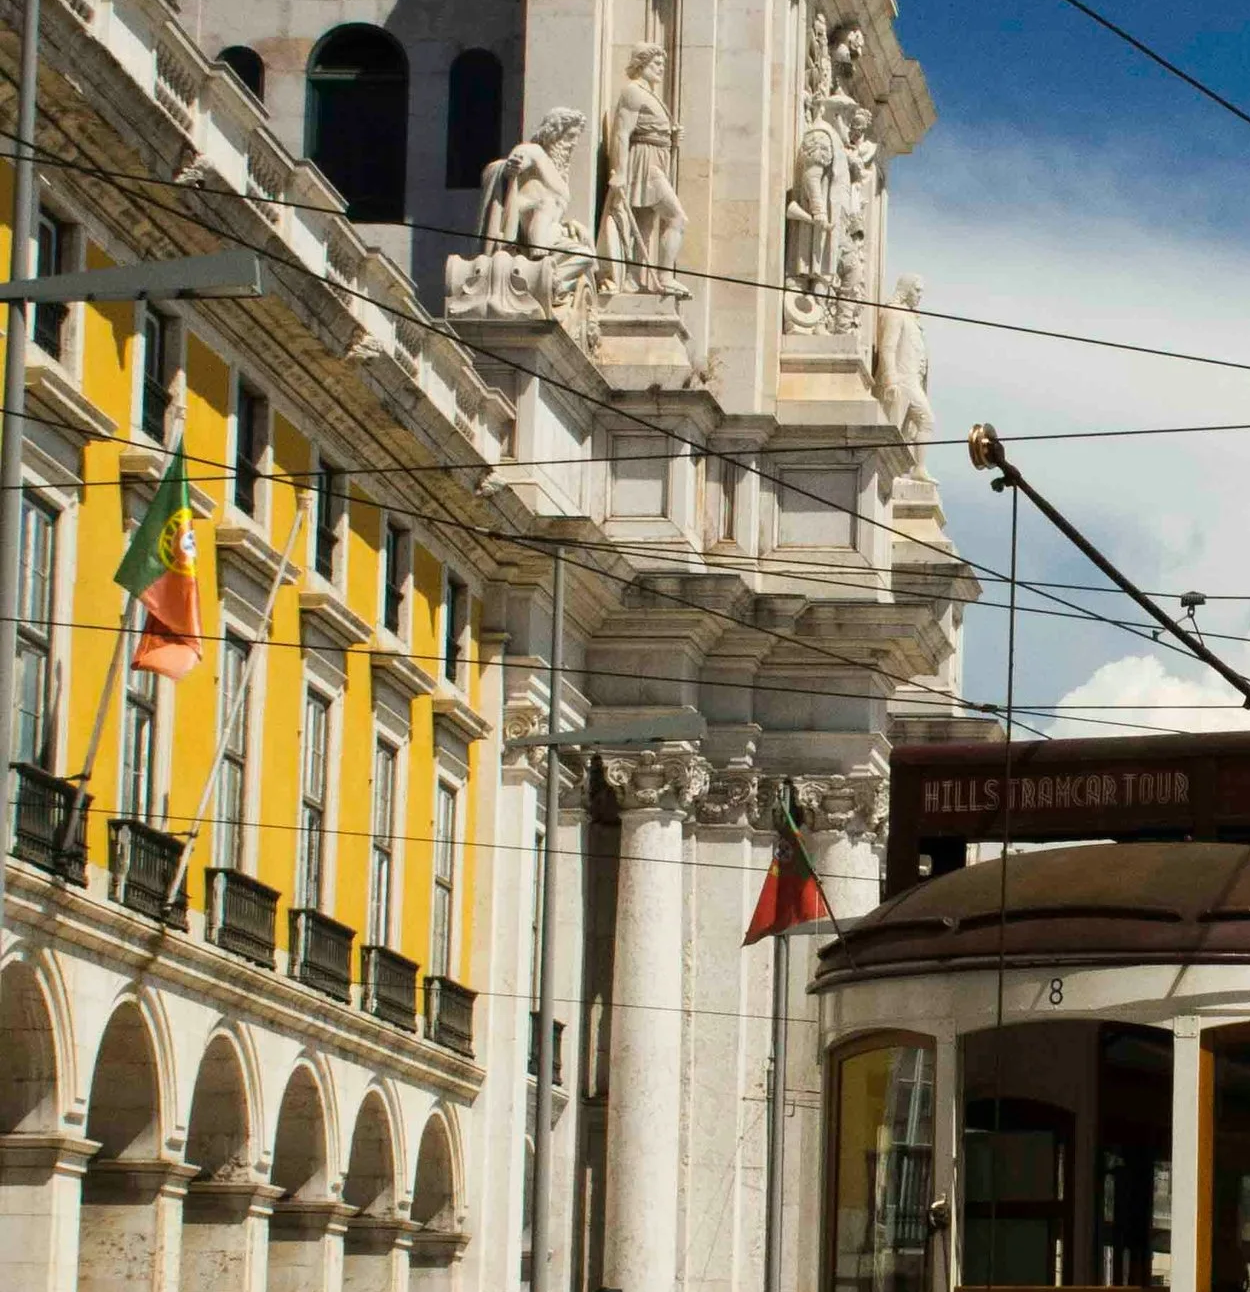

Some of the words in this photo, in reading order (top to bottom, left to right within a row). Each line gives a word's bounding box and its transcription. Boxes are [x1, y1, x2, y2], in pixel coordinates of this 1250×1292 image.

[925, 780, 999, 812] HILLS
[1007, 774, 1117, 809] TRAMCAR
[1122, 772, 1190, 805] TOUR
[1049, 978, 1063, 1005] 8
